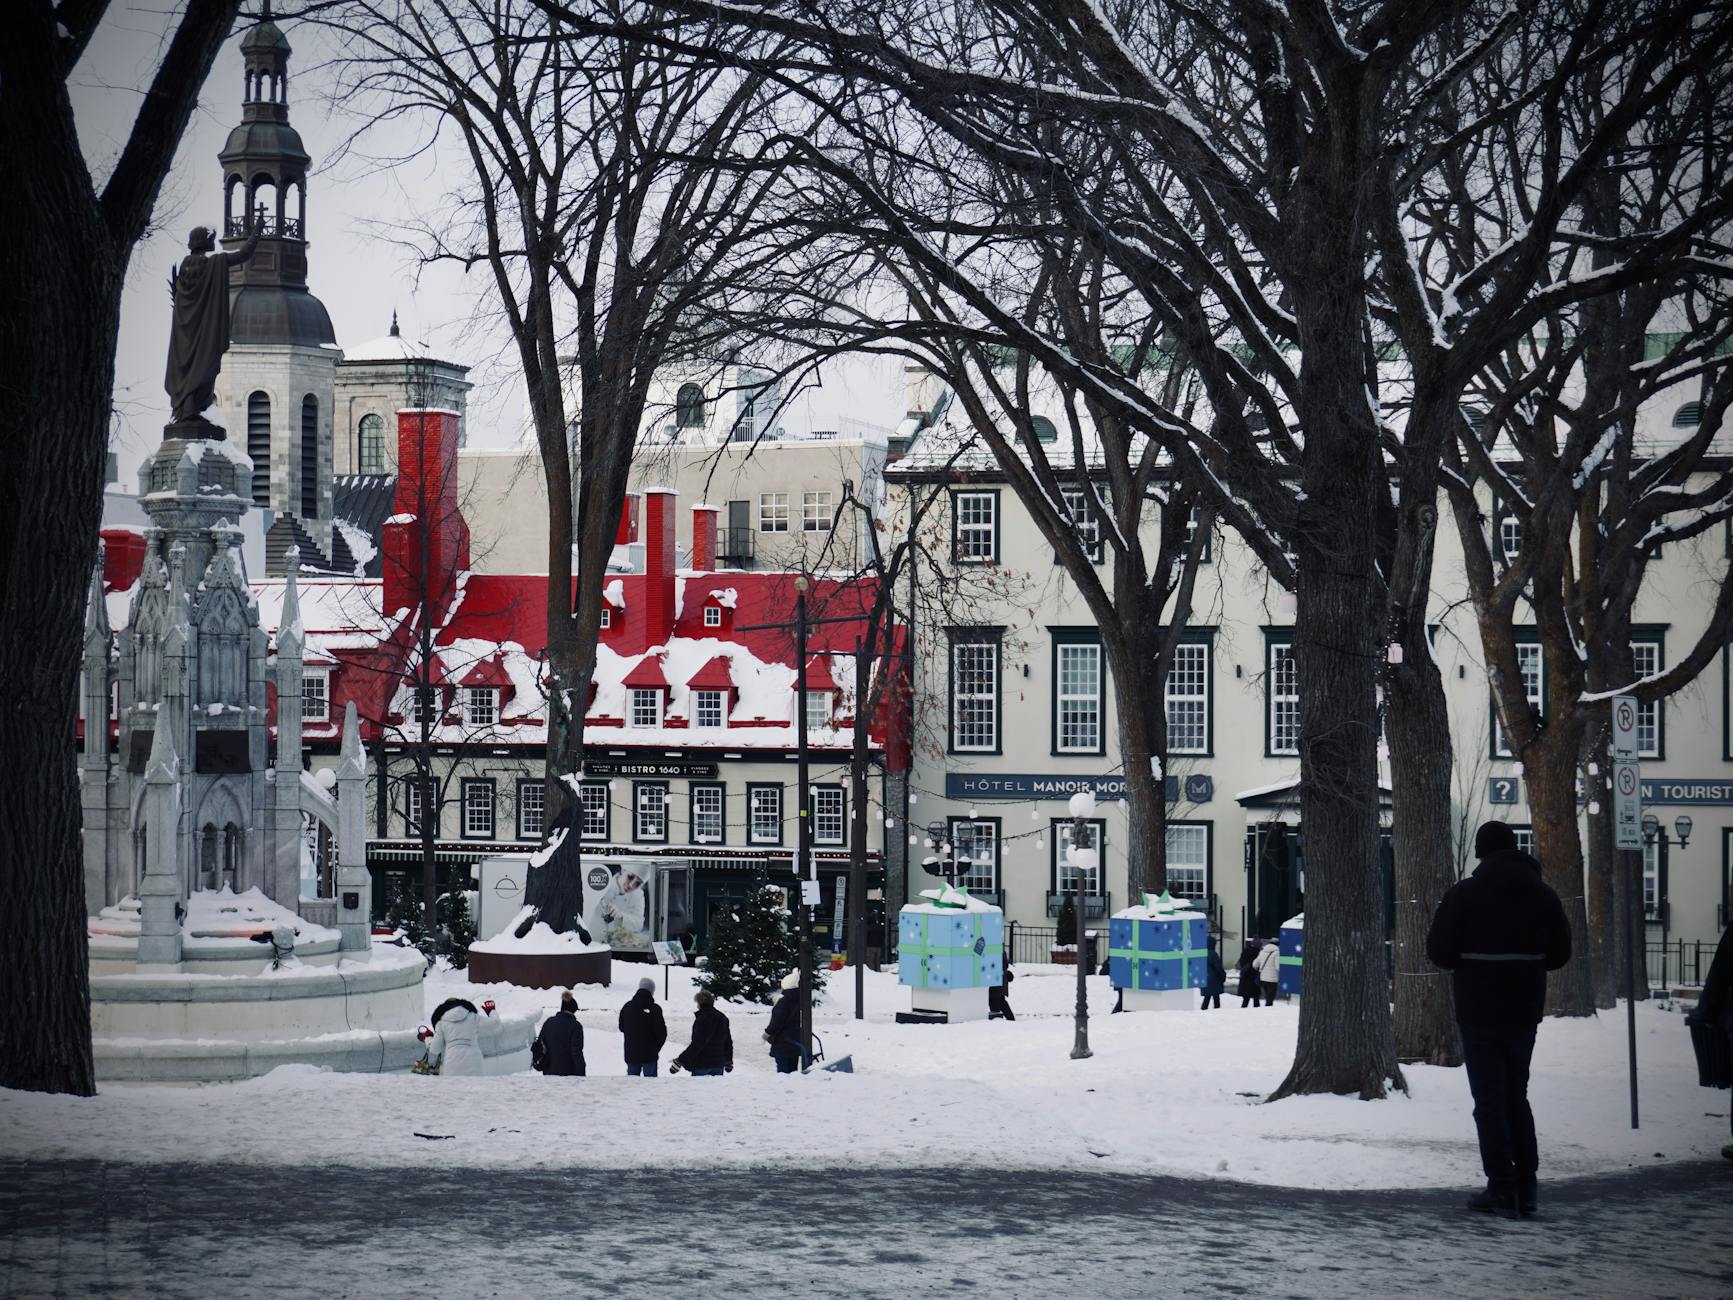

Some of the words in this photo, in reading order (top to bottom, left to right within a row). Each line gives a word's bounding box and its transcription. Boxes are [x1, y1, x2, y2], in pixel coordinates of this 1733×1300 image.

[621, 765, 656, 774] BISTRO
[659, 765, 680, 774] 1640
[964, 778, 1026, 791] HÔTEL
[1033, 781, 1090, 793] MANOIR
[1661, 785, 1732, 800] TOURIST
